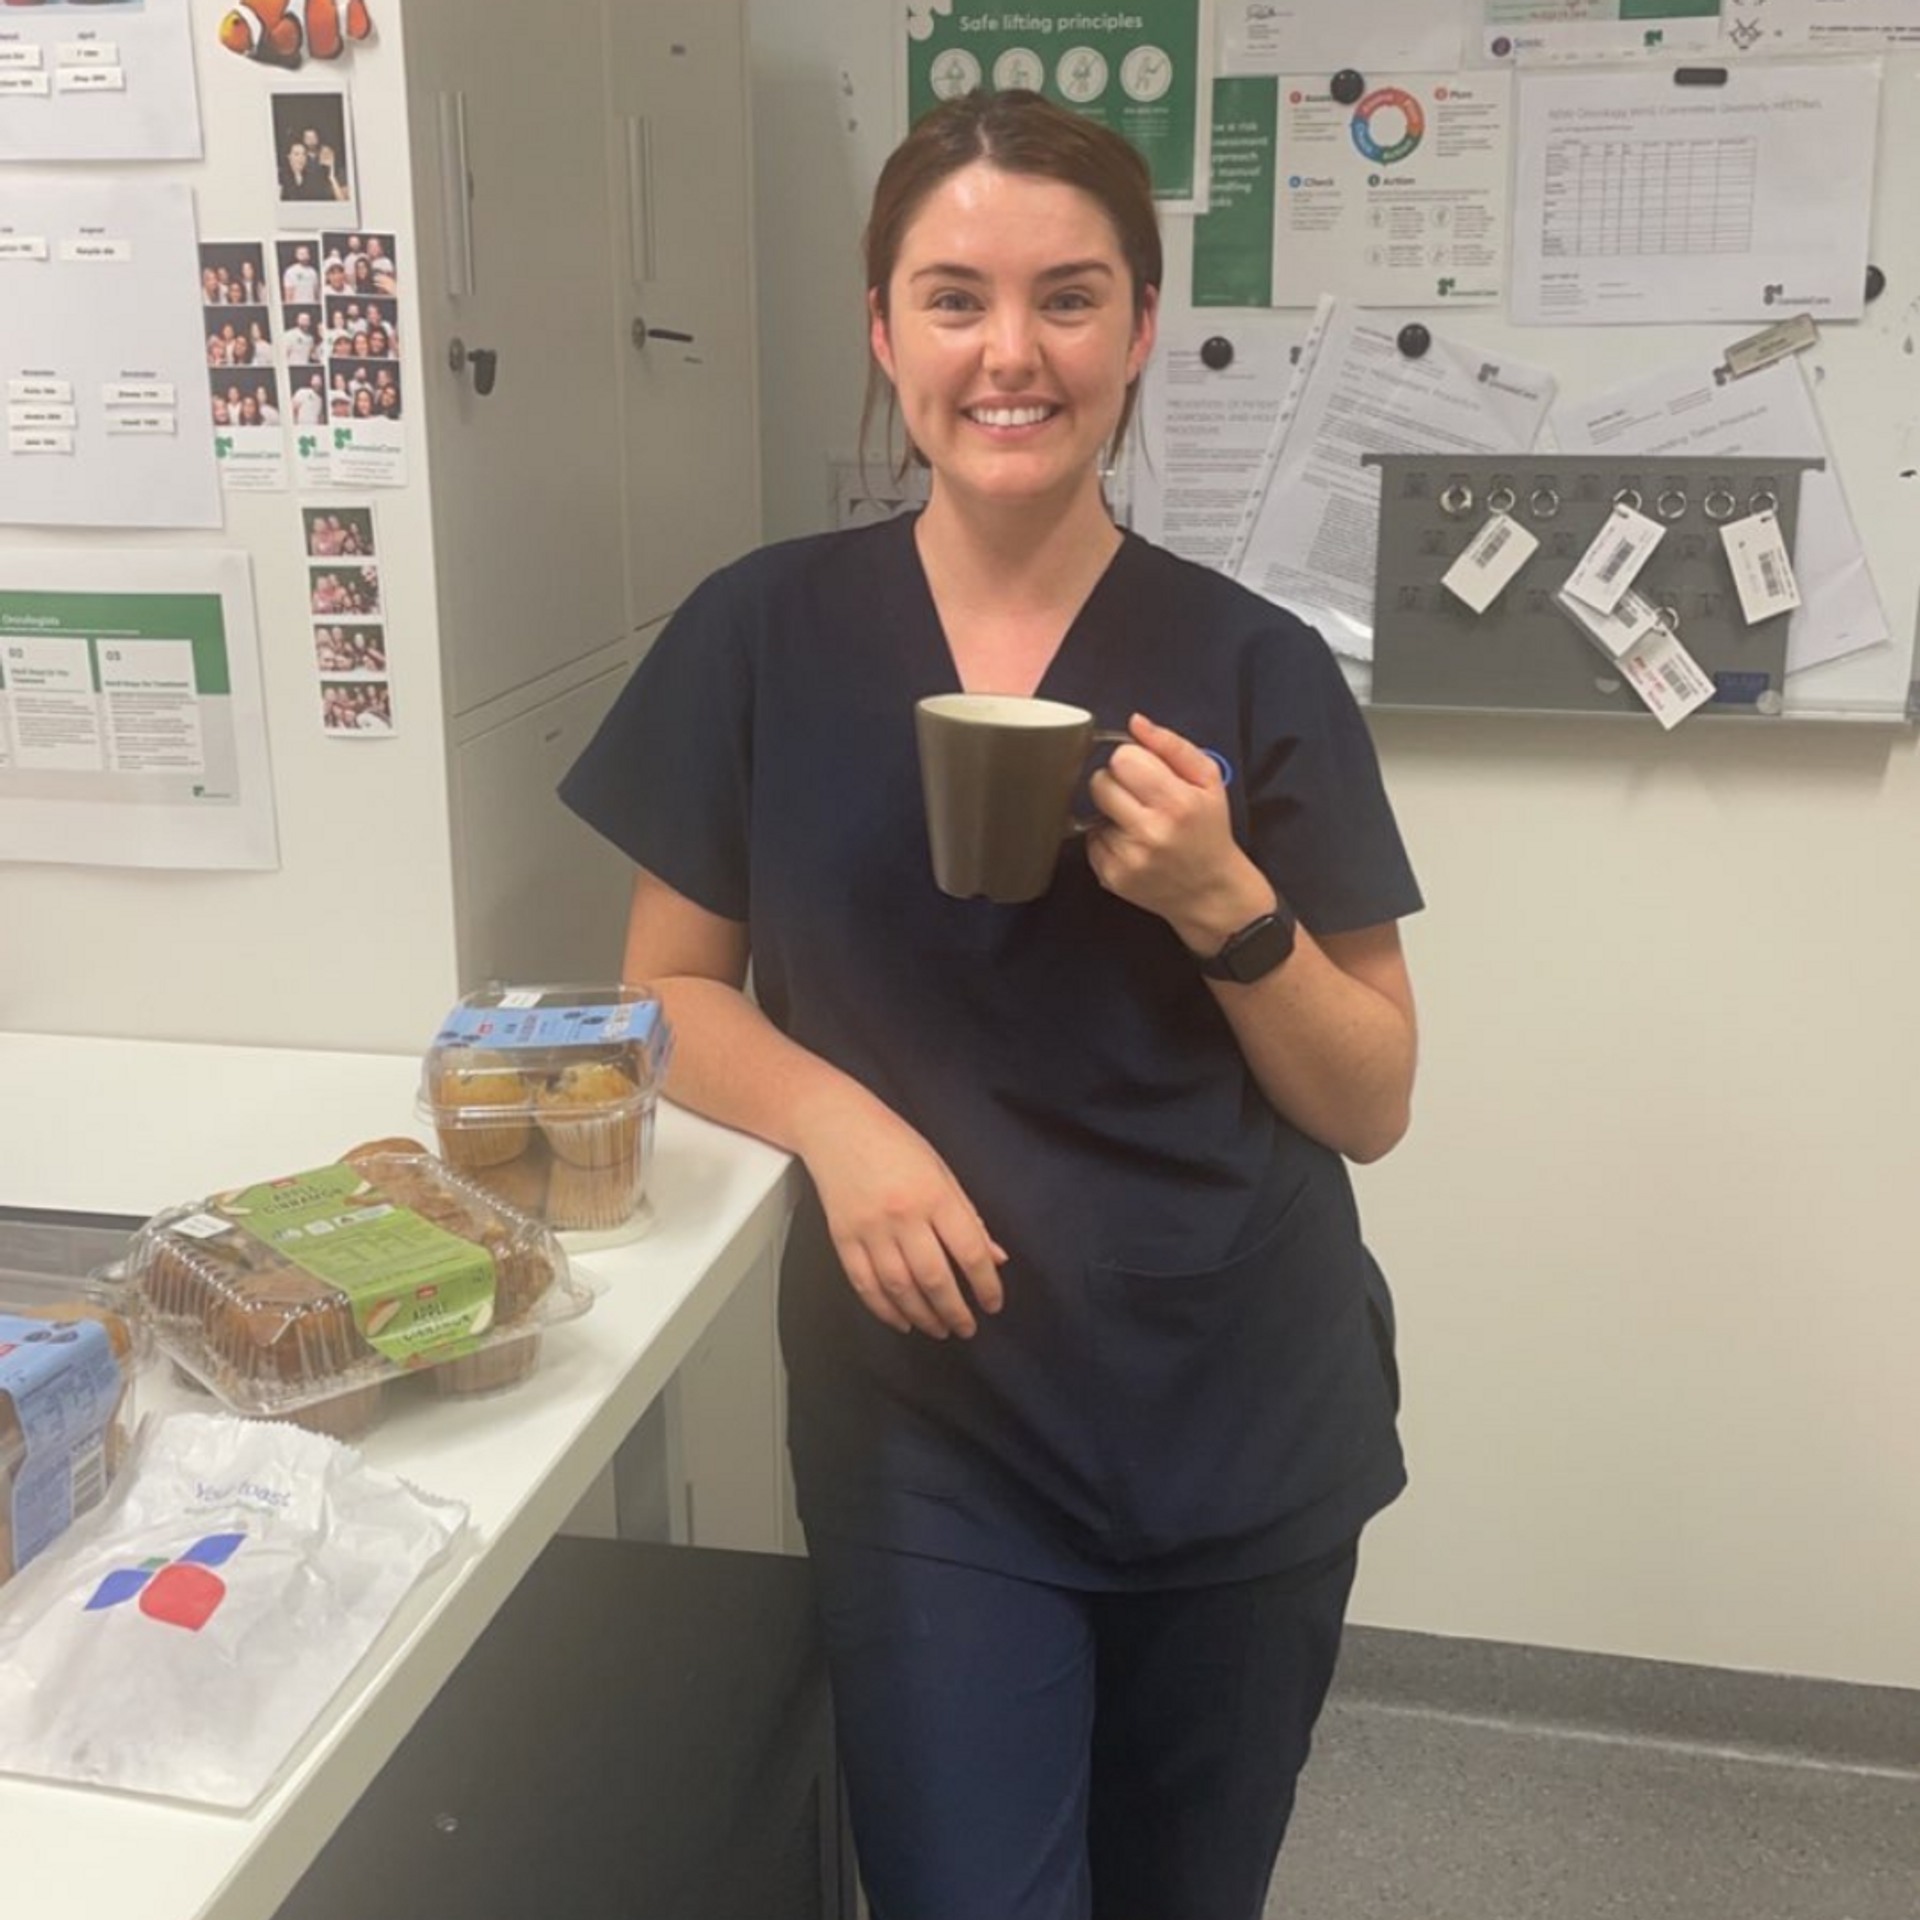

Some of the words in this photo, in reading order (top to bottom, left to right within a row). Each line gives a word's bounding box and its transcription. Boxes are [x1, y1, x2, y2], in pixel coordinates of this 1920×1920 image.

[959, 14, 998, 32] Safe
[1003, 13, 1052, 33] lifting
[1057, 13, 1144, 31] principles
[1237, 122, 1258, 132] risk
[1304, 176, 1334, 188] Check
[1383, 176, 1415, 186] Action
